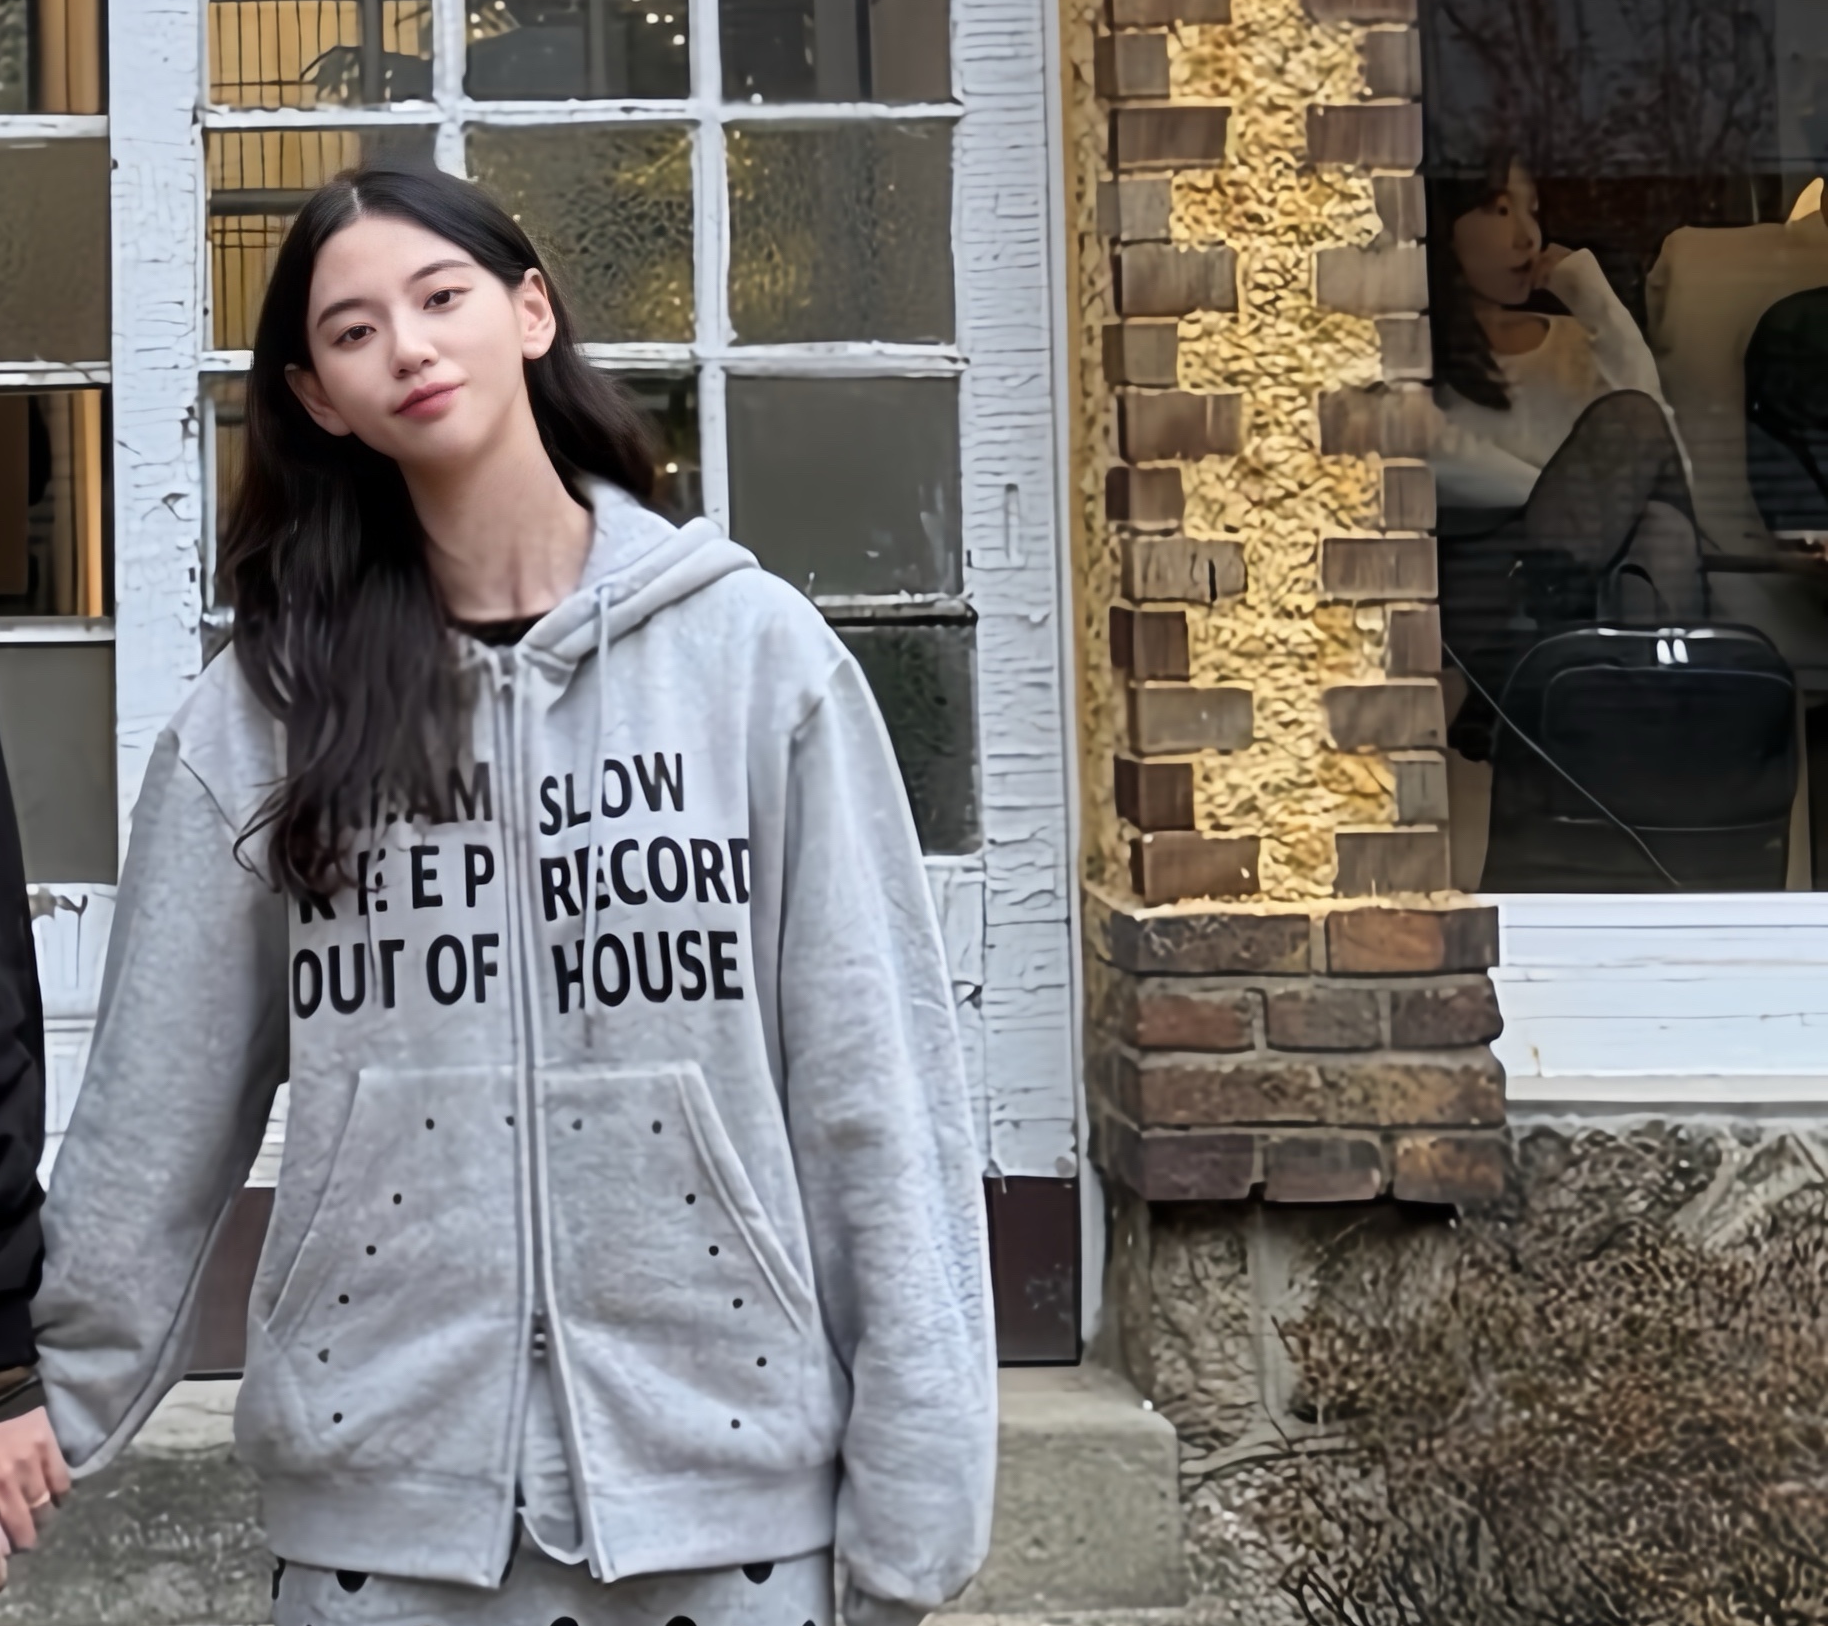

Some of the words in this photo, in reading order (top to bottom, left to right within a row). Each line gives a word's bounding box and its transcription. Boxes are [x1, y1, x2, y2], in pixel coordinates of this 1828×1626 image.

[539, 752, 684, 836] SLOW
[292, 938, 405, 1020] OUT
[425, 933, 499, 1005] OF
[551, 930, 744, 1014] HOUSE
